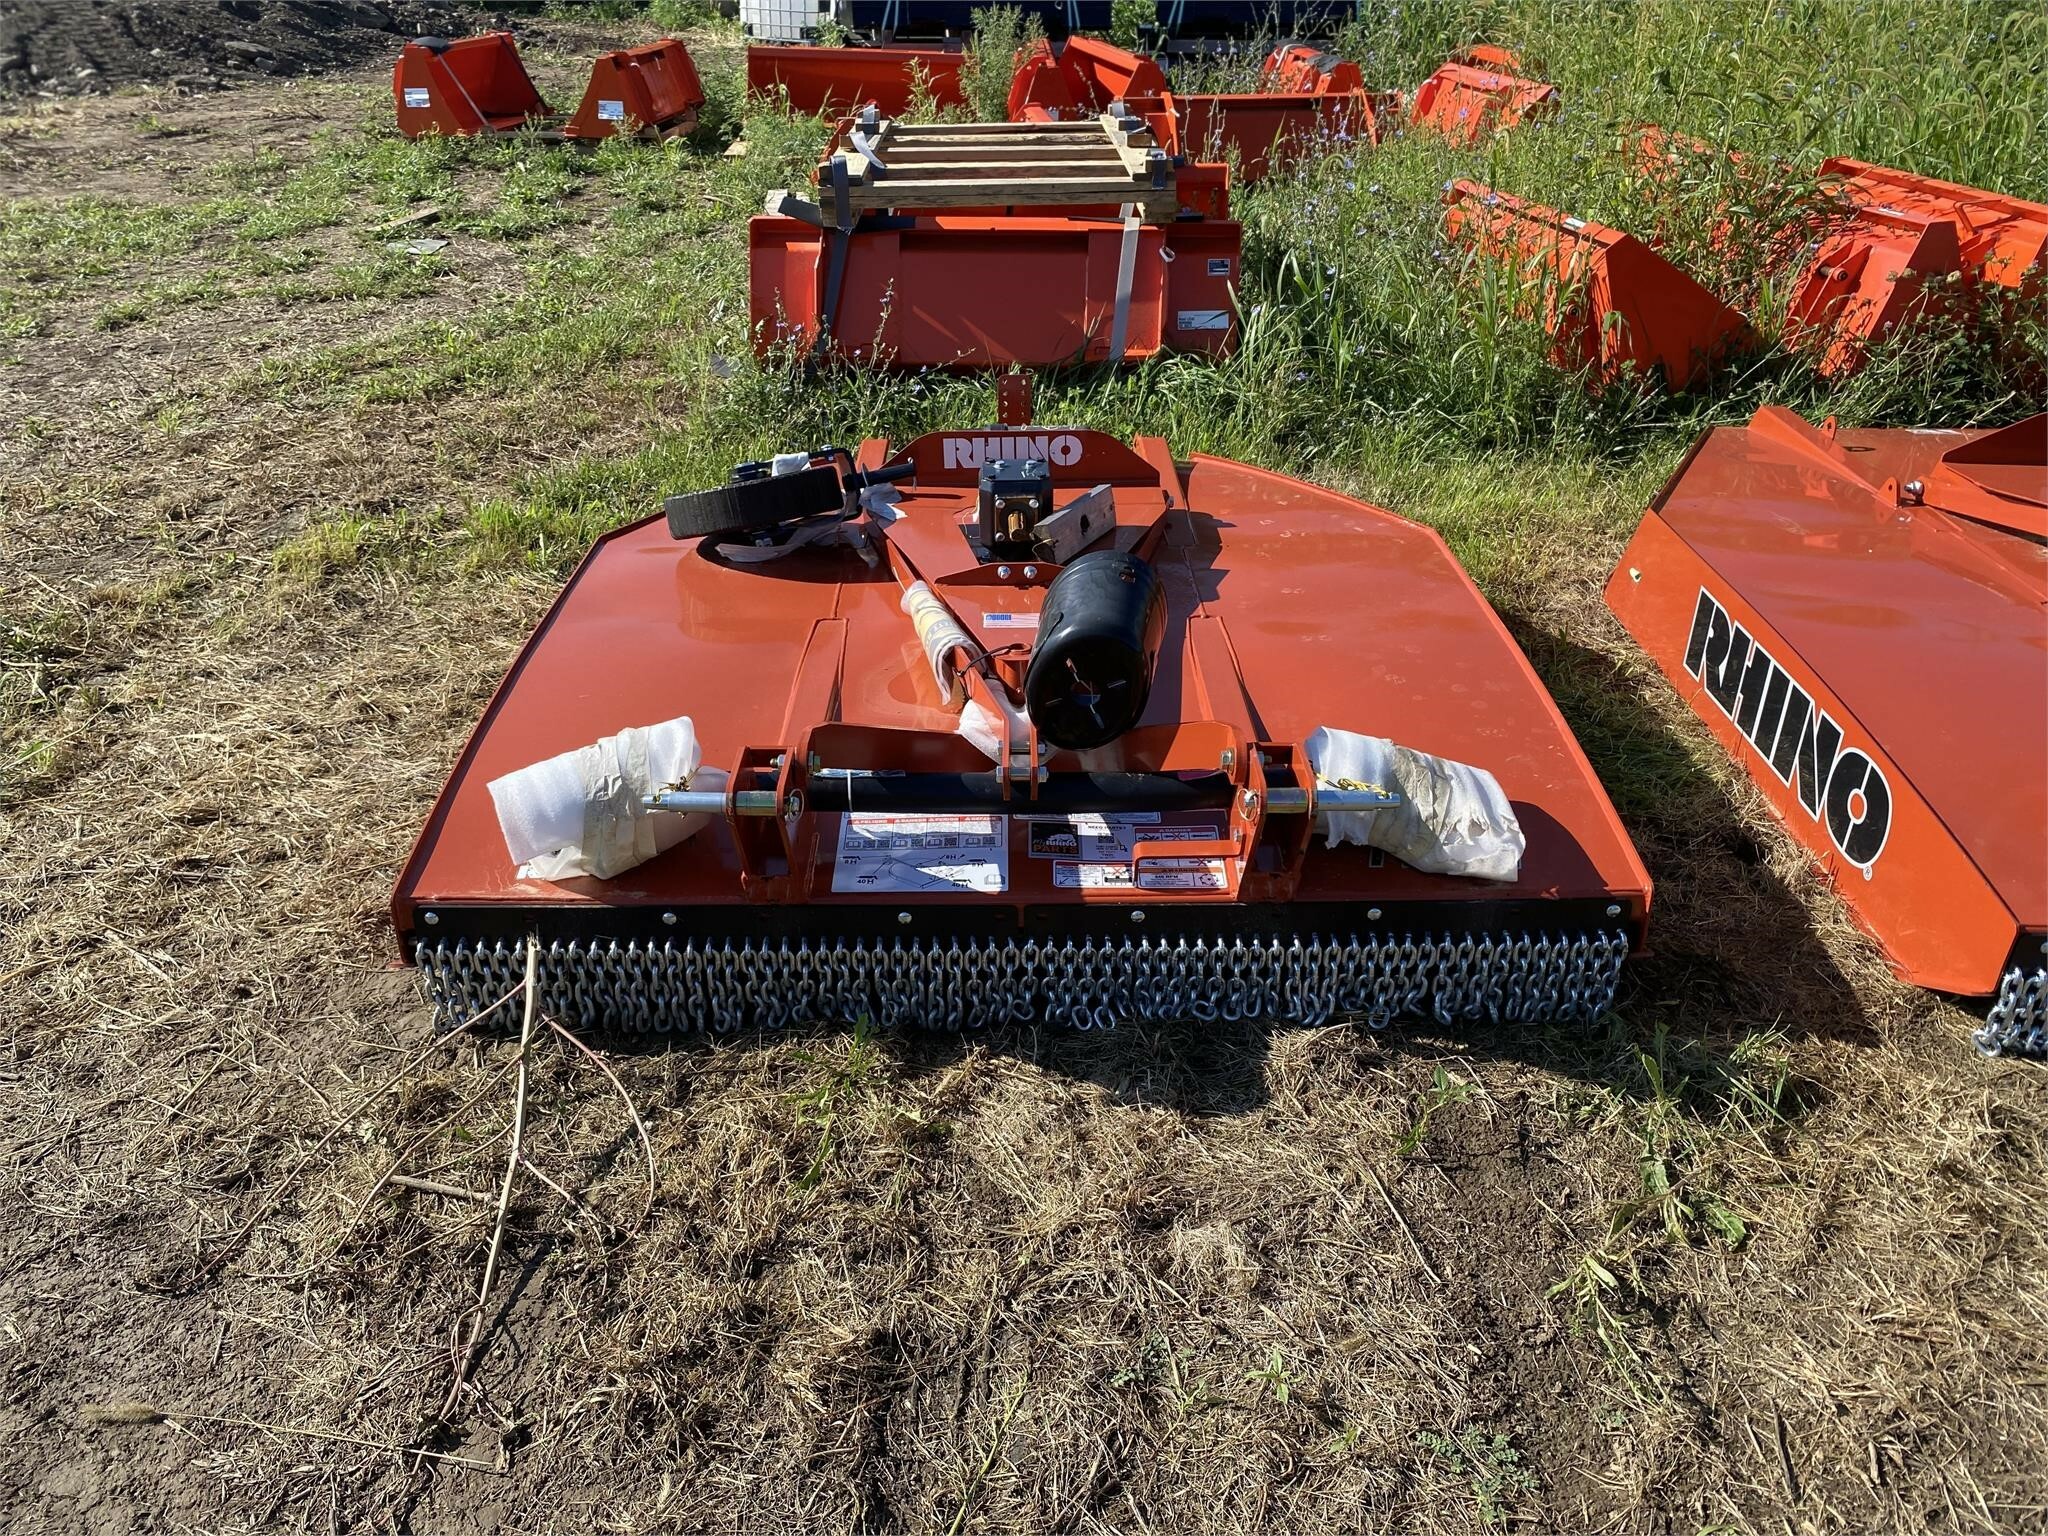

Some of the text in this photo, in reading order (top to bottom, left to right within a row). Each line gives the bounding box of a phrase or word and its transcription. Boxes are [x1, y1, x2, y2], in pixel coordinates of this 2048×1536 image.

[942, 434, 1083, 469] RHINO
[1683, 585, 1893, 870] RHINO
[1033, 845, 1078, 853] PARTS
